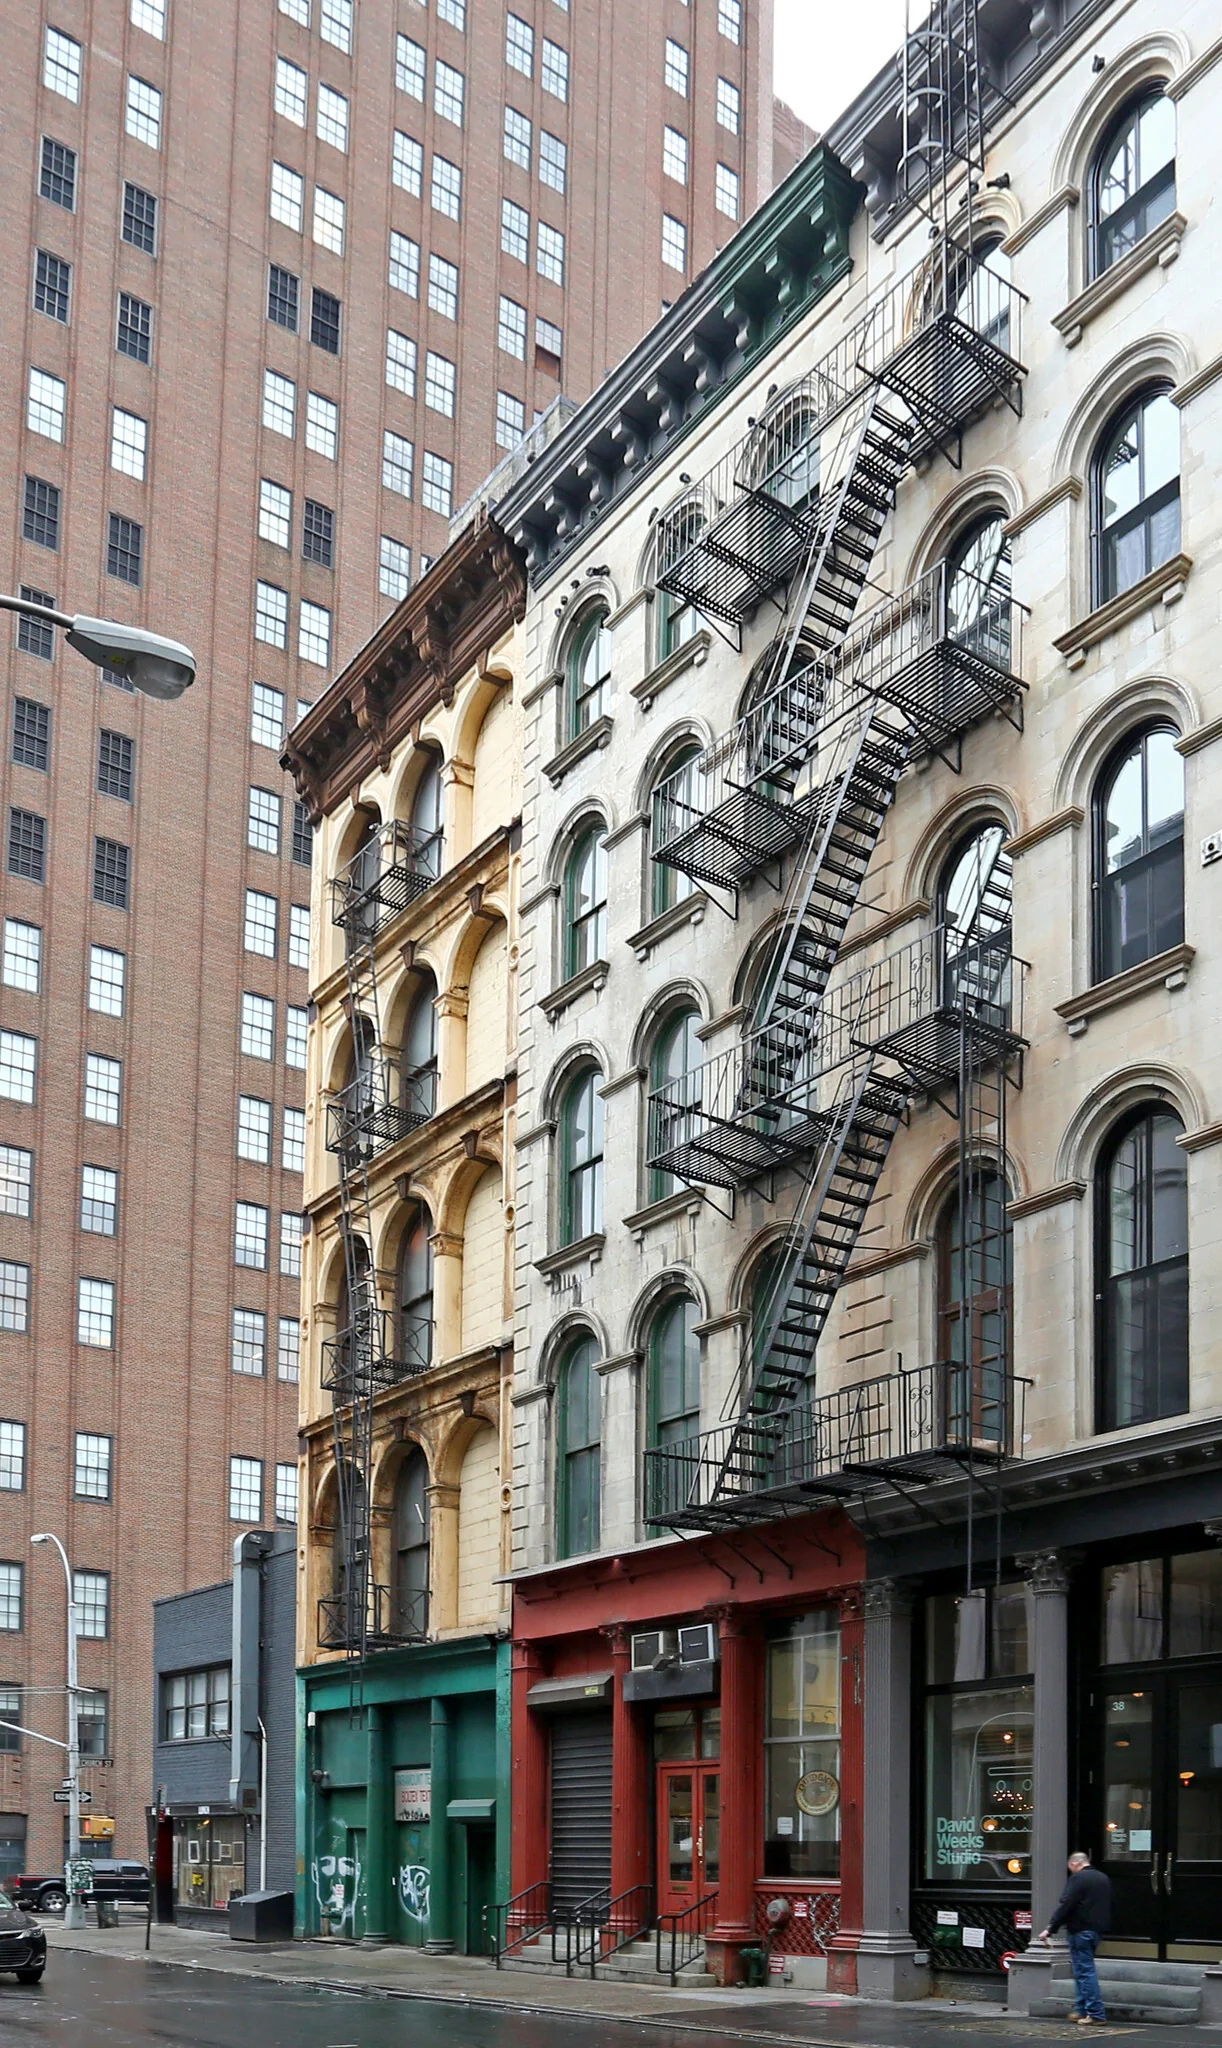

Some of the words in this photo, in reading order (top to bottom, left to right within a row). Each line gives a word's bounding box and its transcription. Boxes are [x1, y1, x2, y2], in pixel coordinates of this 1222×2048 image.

[1112, 1701, 1125, 1711] 38
[937, 1816, 976, 1833] David
[936, 1833, 985, 1849] Weeks
[936, 1849, 981, 1865] Studio
